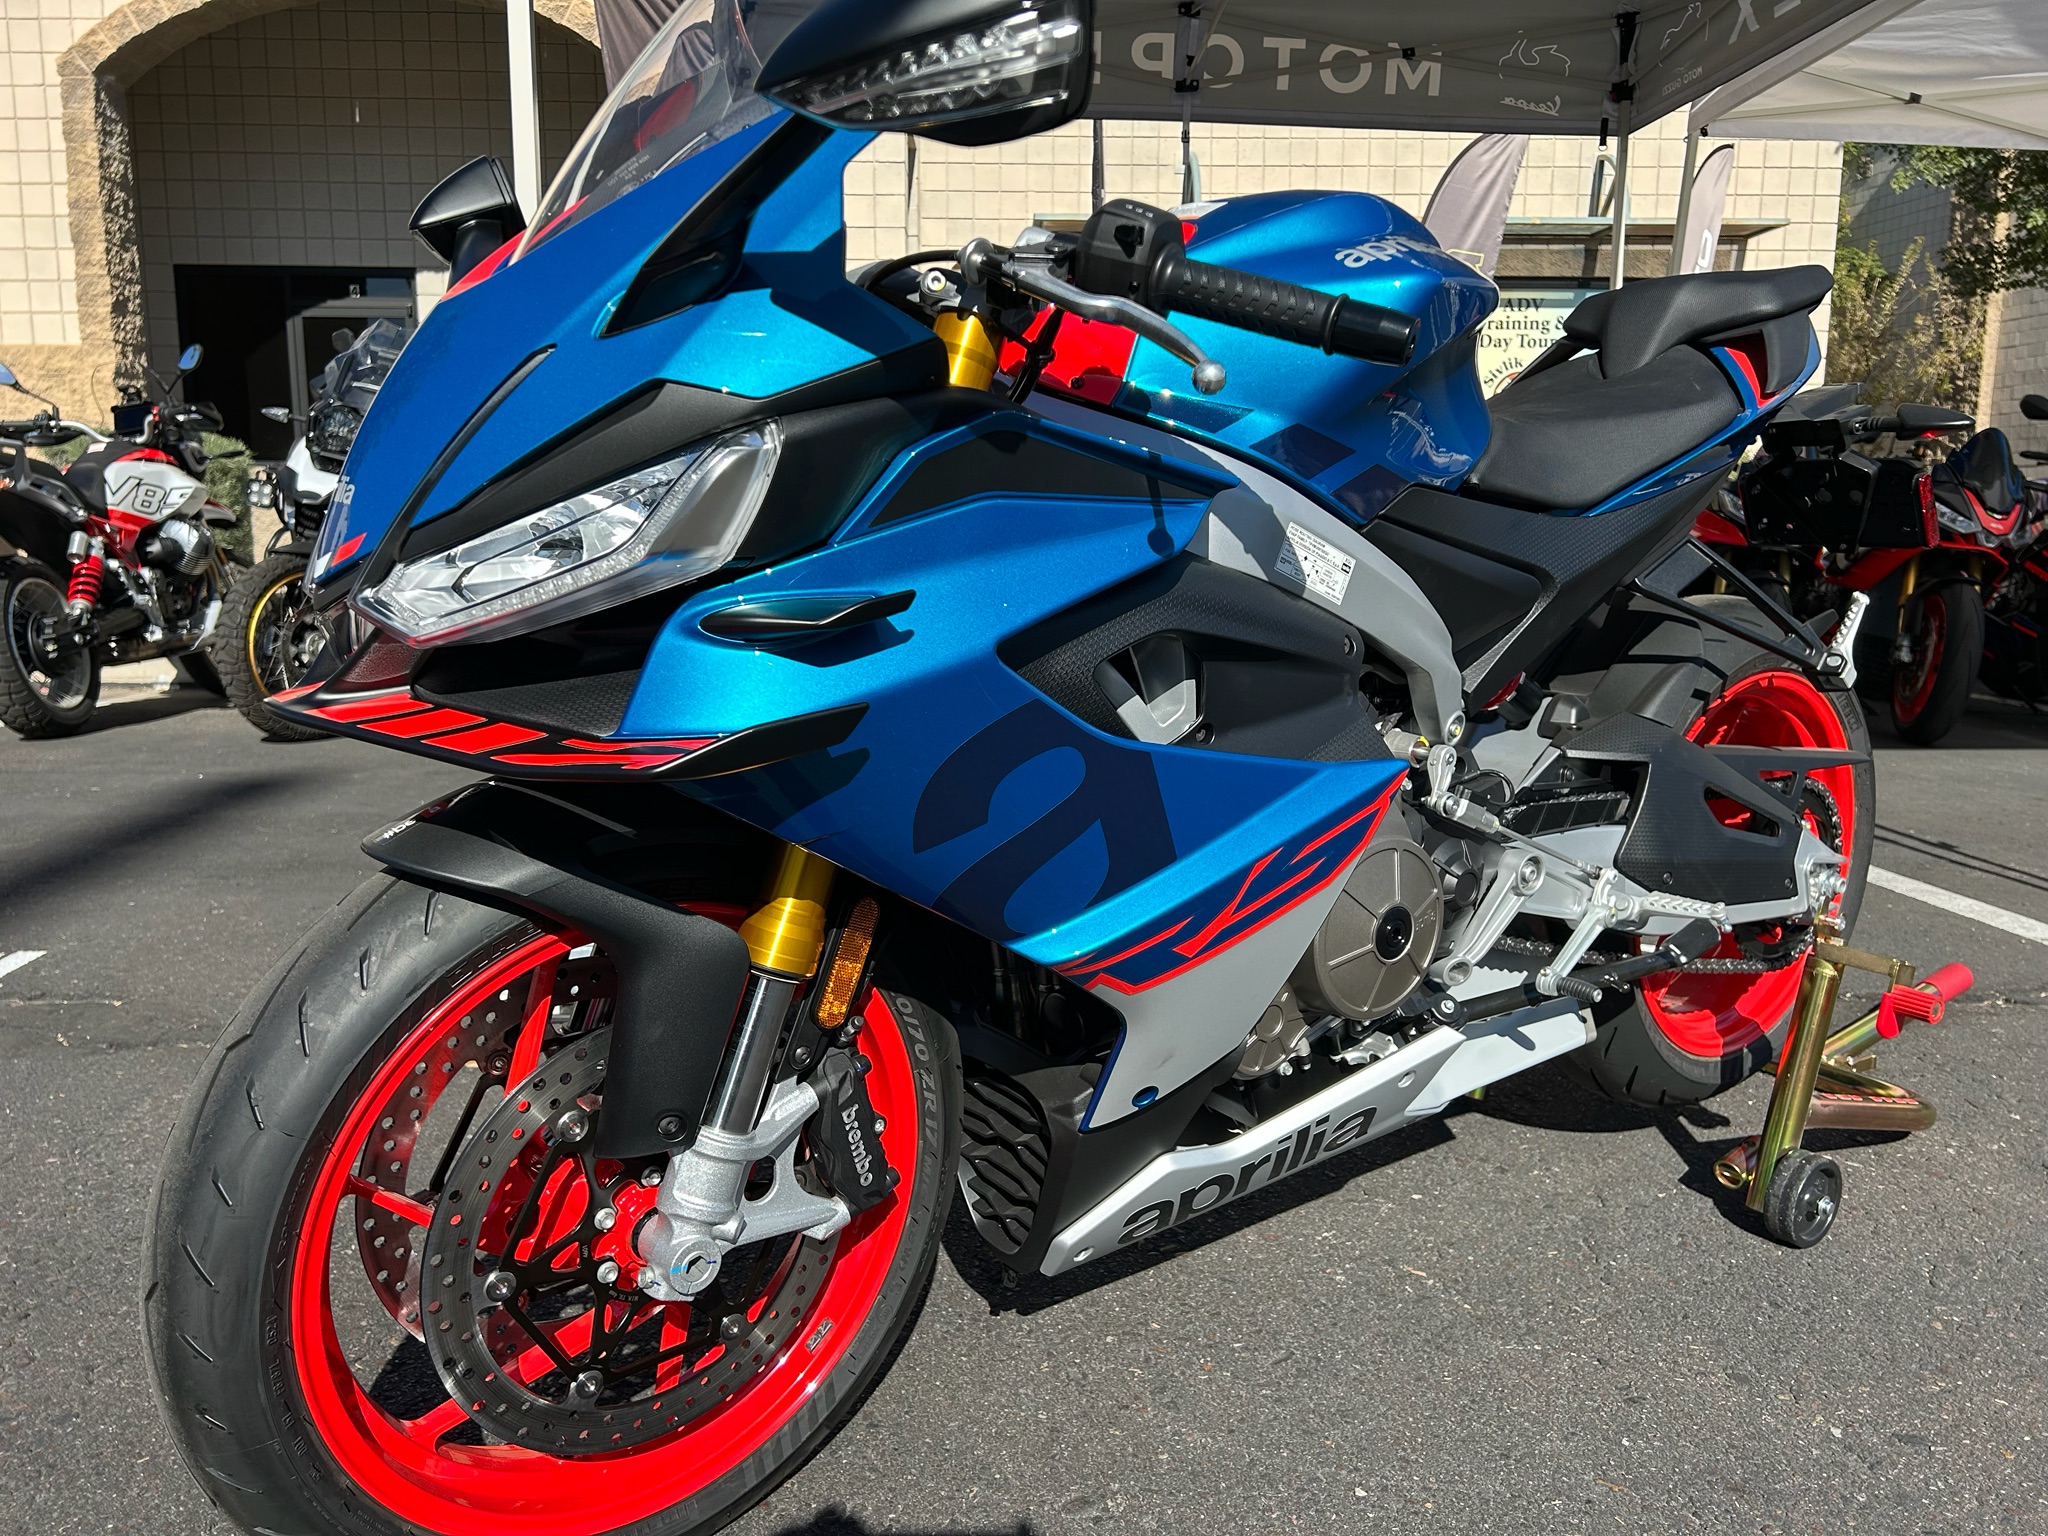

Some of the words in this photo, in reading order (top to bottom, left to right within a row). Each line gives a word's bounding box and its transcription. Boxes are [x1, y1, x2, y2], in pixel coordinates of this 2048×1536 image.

[1503, 298, 1546, 312] ADV
[1487, 315, 1551, 335] raining
[1480, 334, 1513, 353] Day
[1516, 333, 1557, 349] Tour
[1483, 357, 1524, 388] Sivlik
[841, 1103, 873, 1187] brembo
[1117, 1106, 1378, 1245] aprilia
